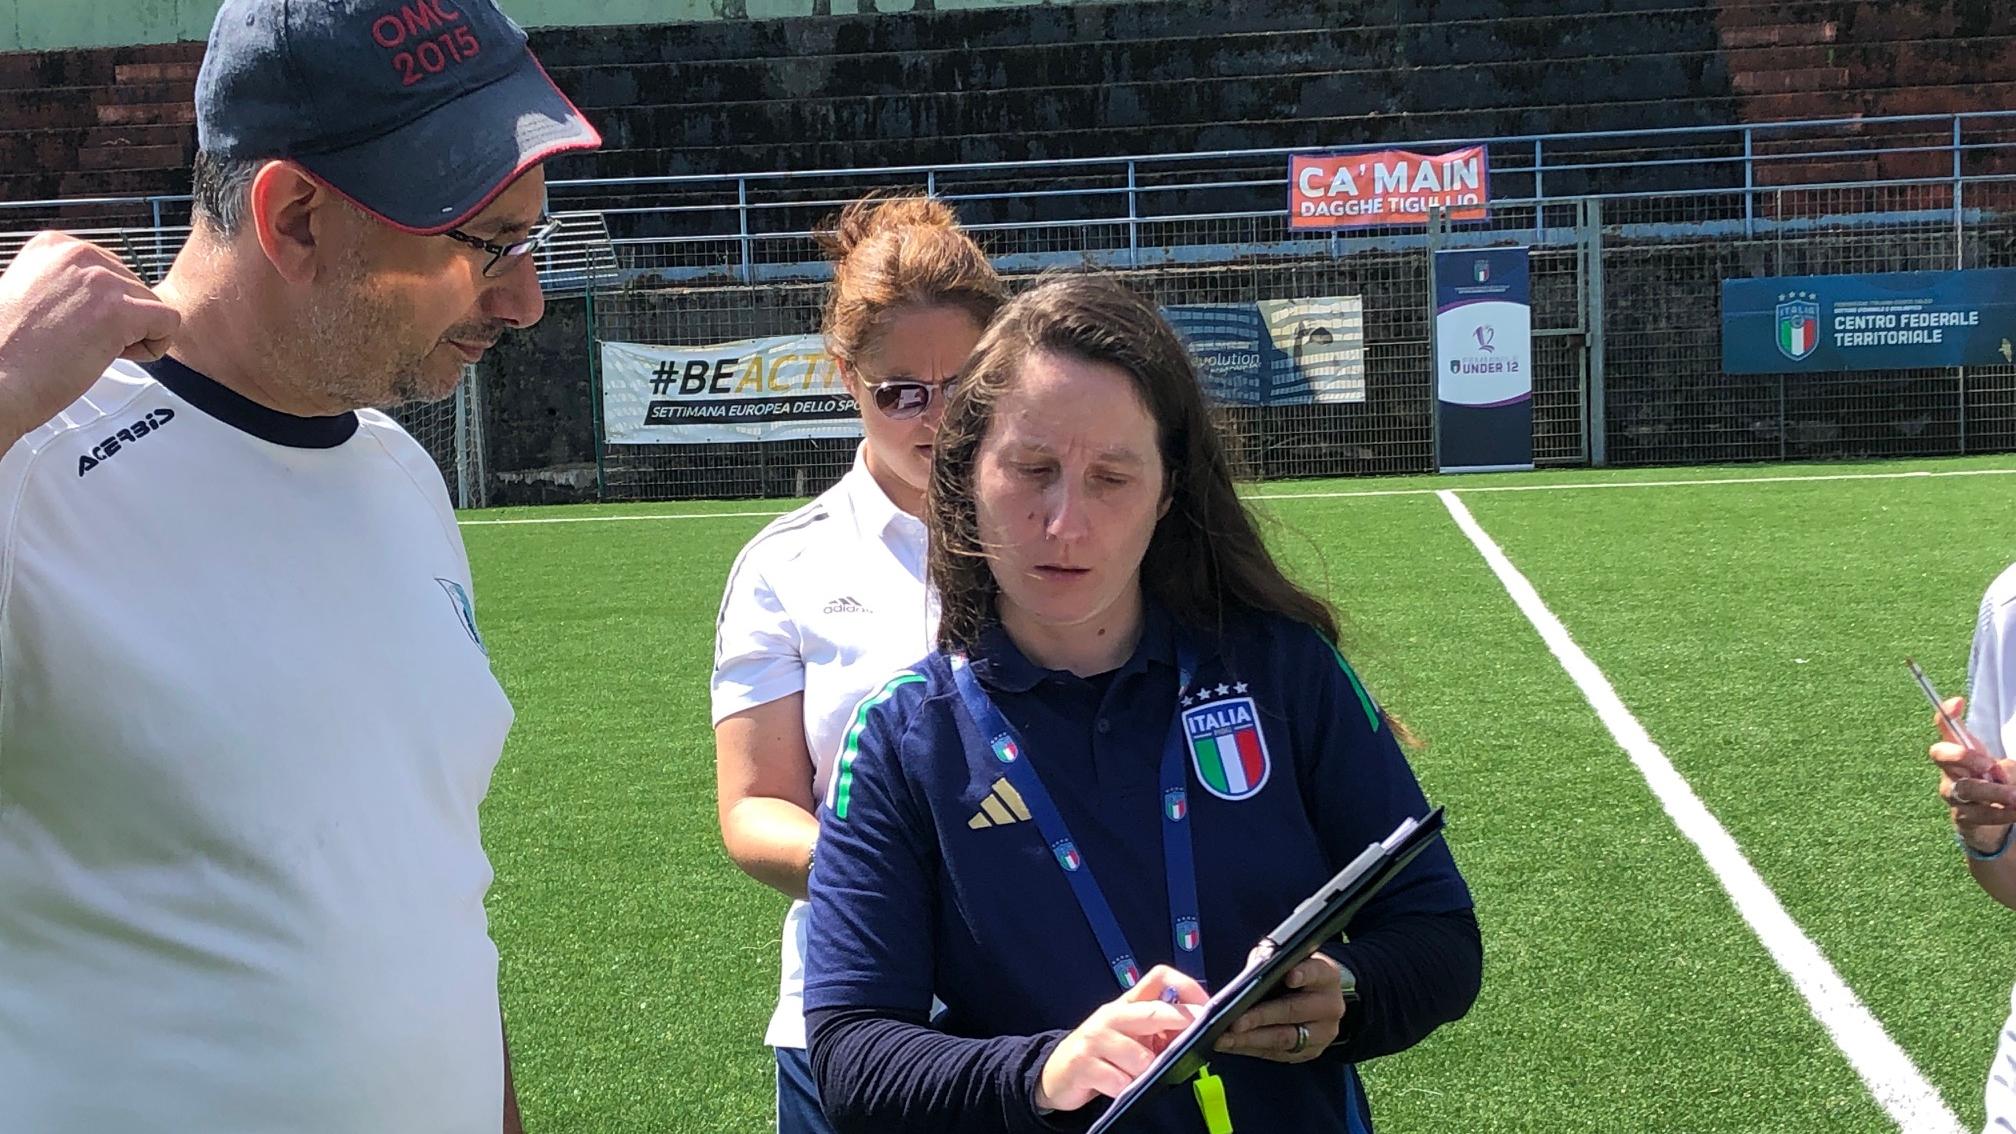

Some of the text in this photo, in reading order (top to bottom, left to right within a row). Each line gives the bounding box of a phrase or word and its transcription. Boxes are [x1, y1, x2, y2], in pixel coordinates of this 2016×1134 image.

[391, 25, 479, 87] 2015
[1301, 197, 1383, 217] DAGGHE
[1834, 311, 1979, 331] CENTRO FEDERALE
[1834, 328, 1943, 347] TERRITORIALE
[650, 352, 837, 396] #BEACTI
[1462, 360, 1519, 375] UNDER 12
[651, 399, 861, 419] SETTIMANA EUROPEA DELLO SPO
[823, 603, 874, 615] adida
[1188, 705, 1252, 734] ITALIA
